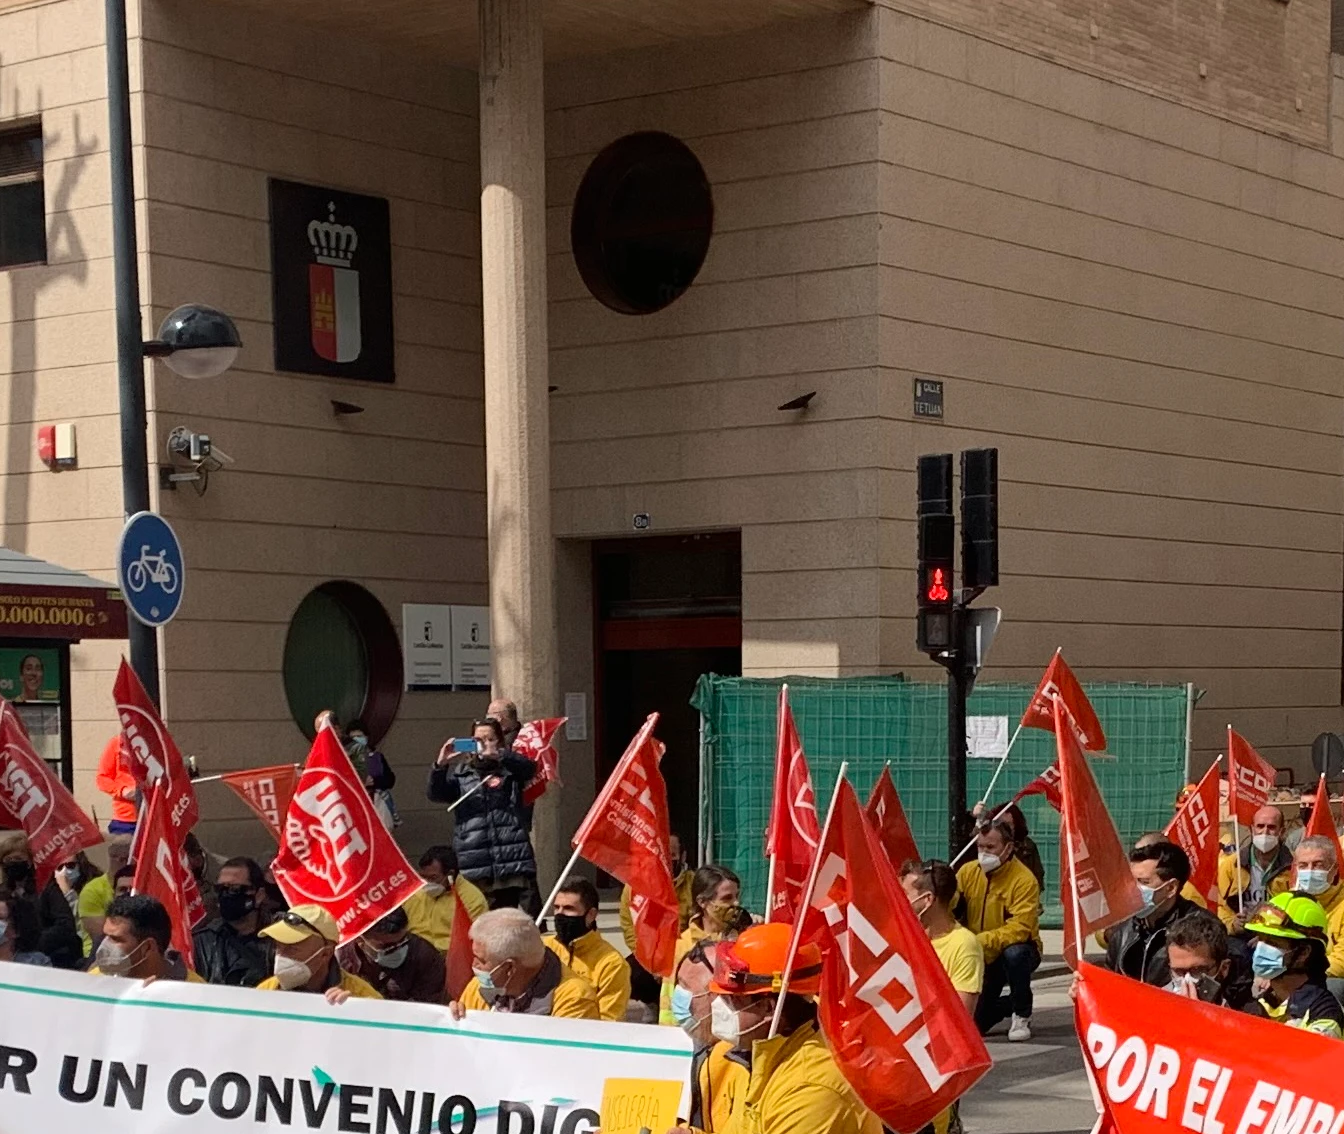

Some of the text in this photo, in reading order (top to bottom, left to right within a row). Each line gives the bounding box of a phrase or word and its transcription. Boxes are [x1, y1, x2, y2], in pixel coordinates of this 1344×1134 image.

[294, 776, 368, 869] UGT
[58, 1054, 149, 1111] UN
[1085, 1022, 1181, 1120] POR
